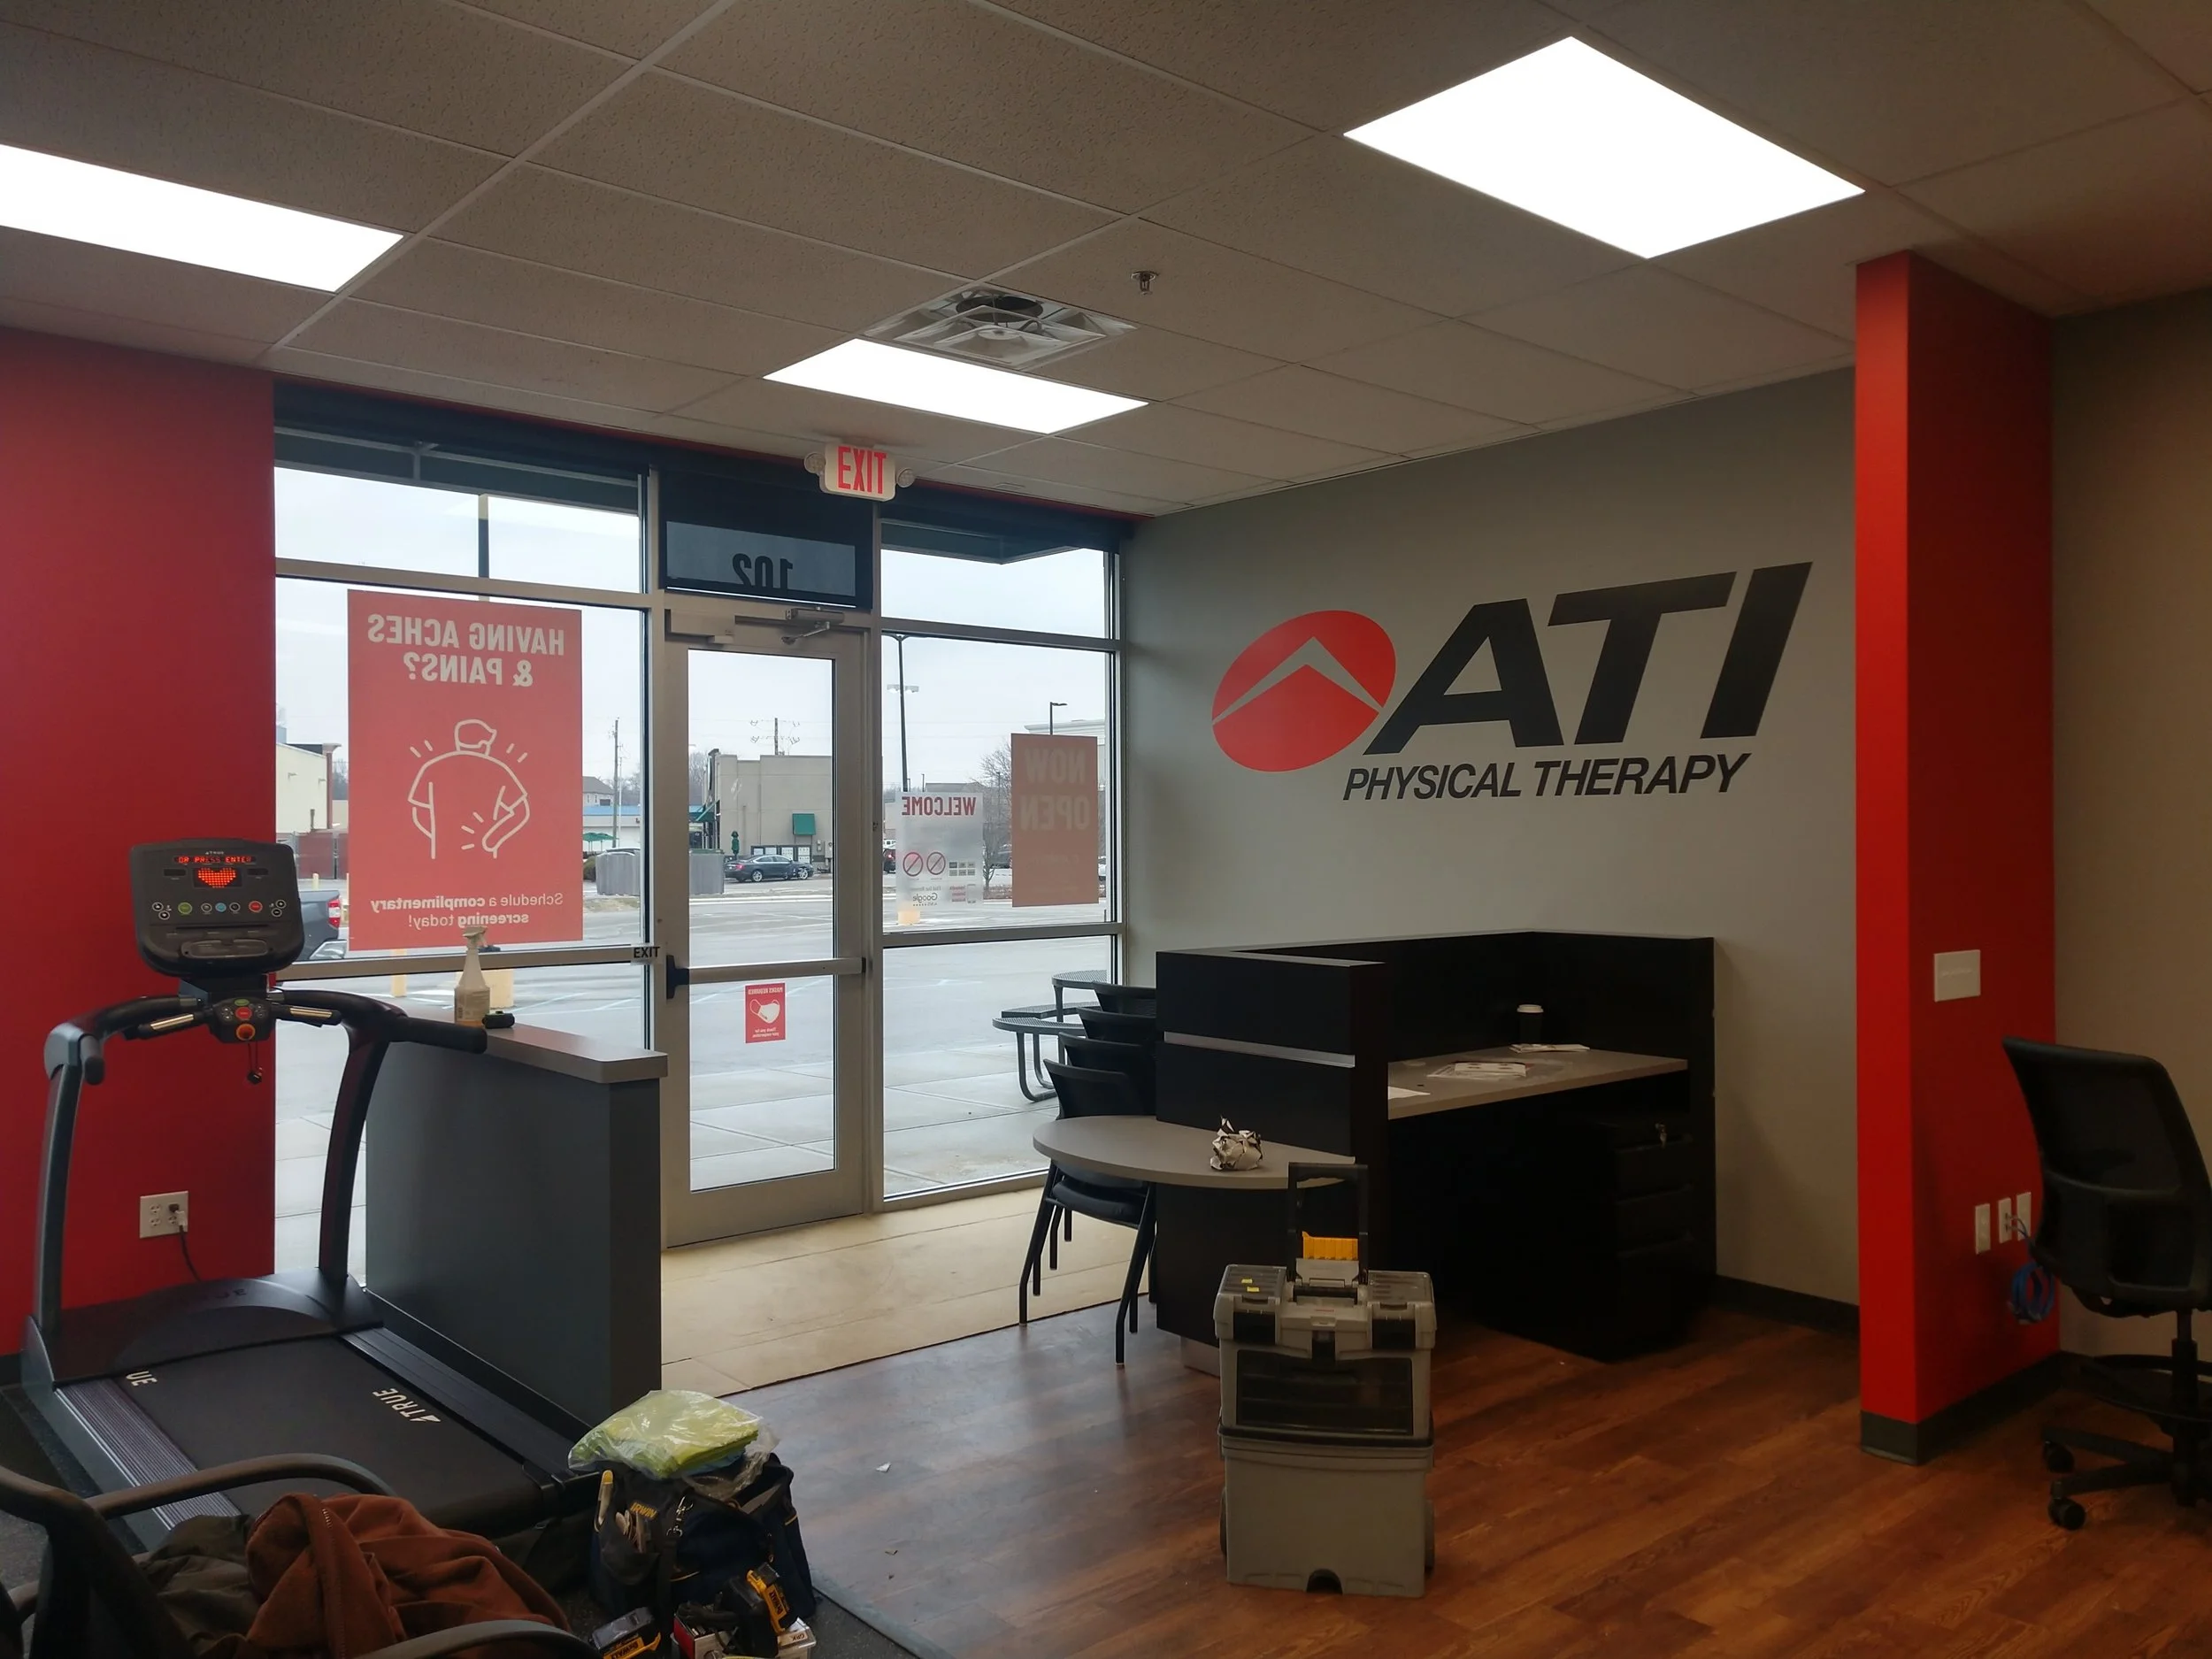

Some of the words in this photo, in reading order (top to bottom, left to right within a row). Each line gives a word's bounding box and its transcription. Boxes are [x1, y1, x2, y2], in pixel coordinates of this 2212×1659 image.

[837, 445, 887, 495] EXIT
[1363, 561, 1813, 756] ATI
[1343, 764, 1523, 801] PHYSICAL
[1532, 752, 1752, 796] THERAPY
[634, 946, 660, 958] EXIT
[126, 1370, 157, 1386] UE
[373, 1387, 426, 1418] TRUE
[630, 1502, 658, 1519] IRWIN
